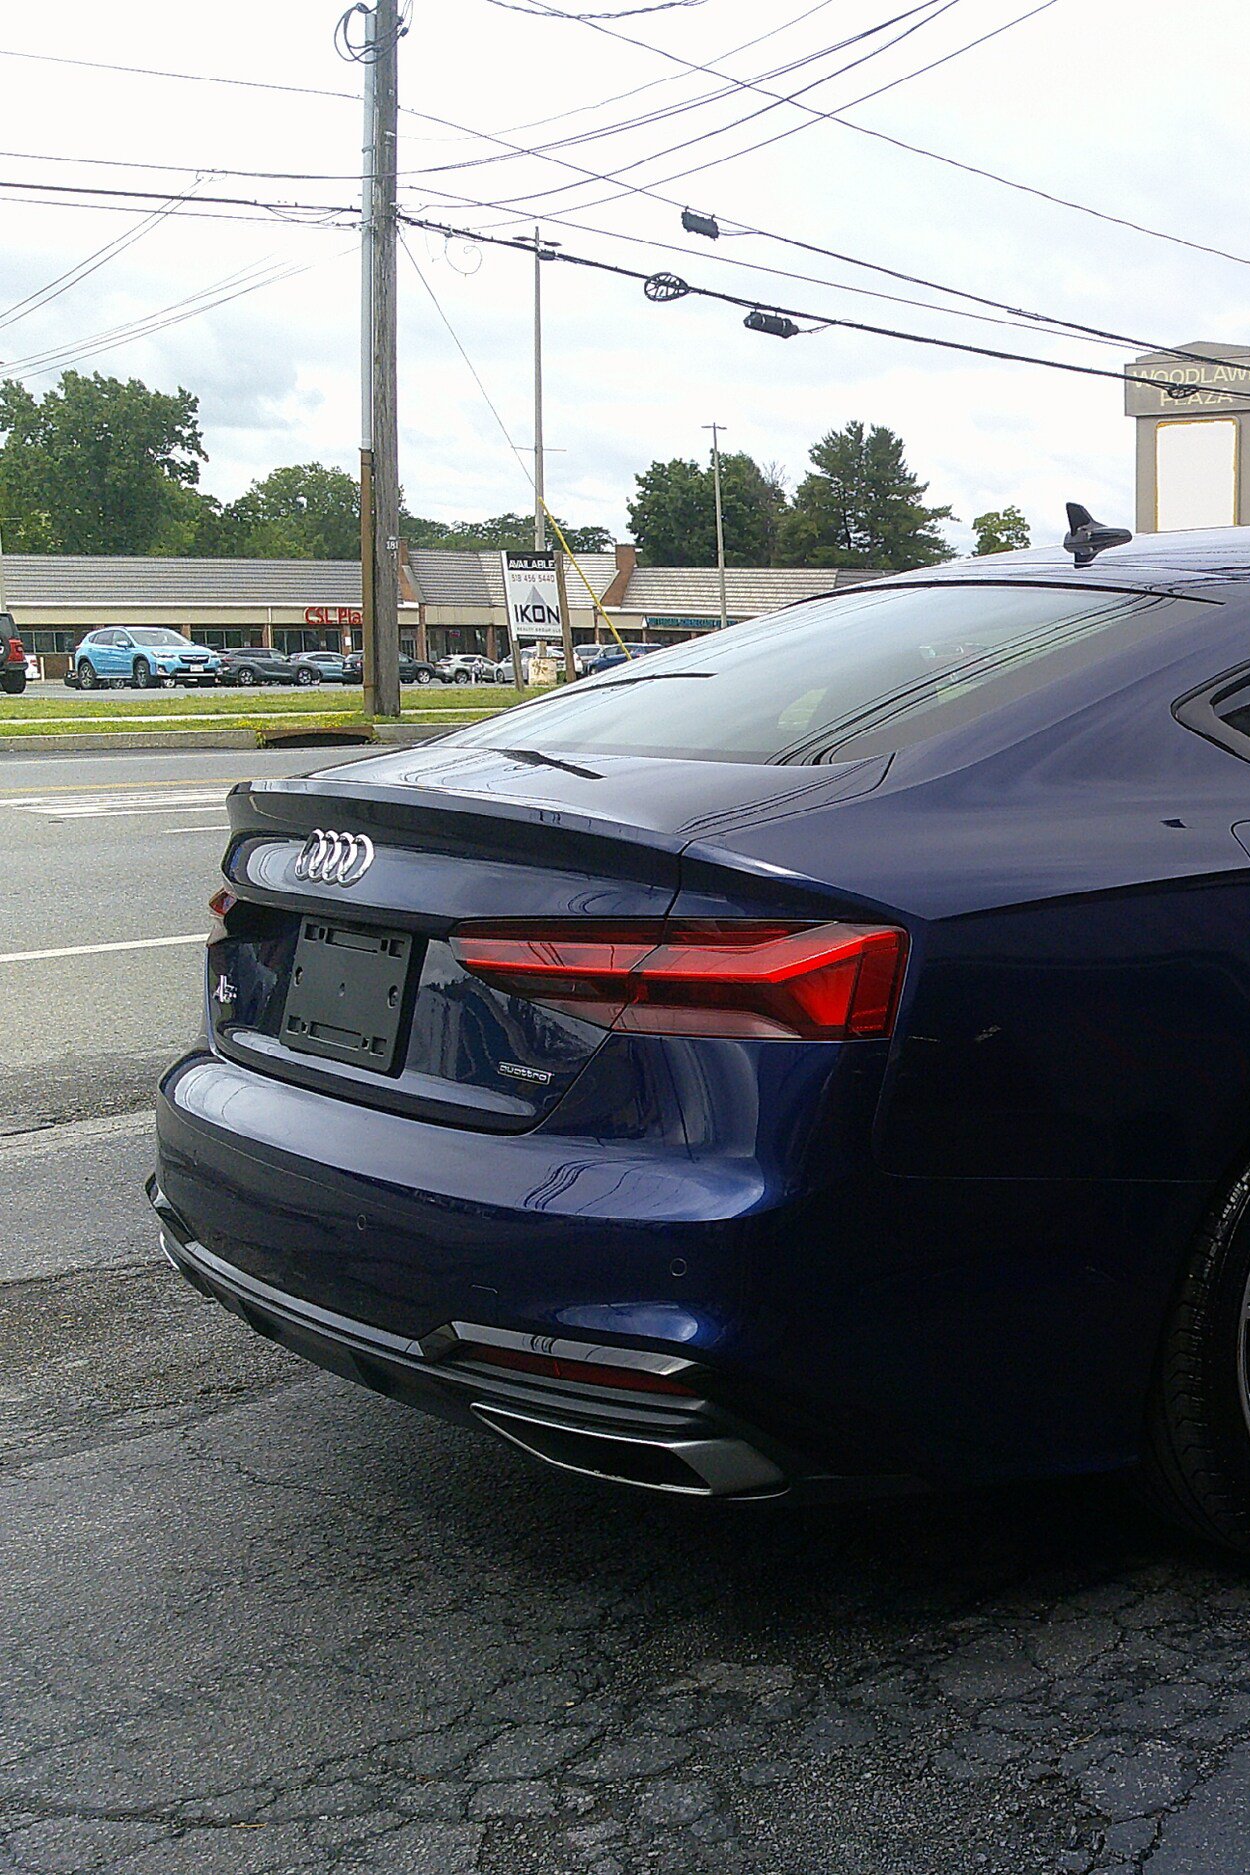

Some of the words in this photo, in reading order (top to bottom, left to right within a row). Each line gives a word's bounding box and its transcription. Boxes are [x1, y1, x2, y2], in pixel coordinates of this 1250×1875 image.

[1159, 387, 1234, 406] PLAZA
[508, 559, 557, 569] AVAILABLE
[524, 574, 536, 583] 456
[538, 574, 555, 583] 5440
[305, 607, 336, 624] CSL
[338, 608, 363, 624] Pla
[514, 604, 560, 624] IKON
[499, 1064, 547, 1081] quattro
